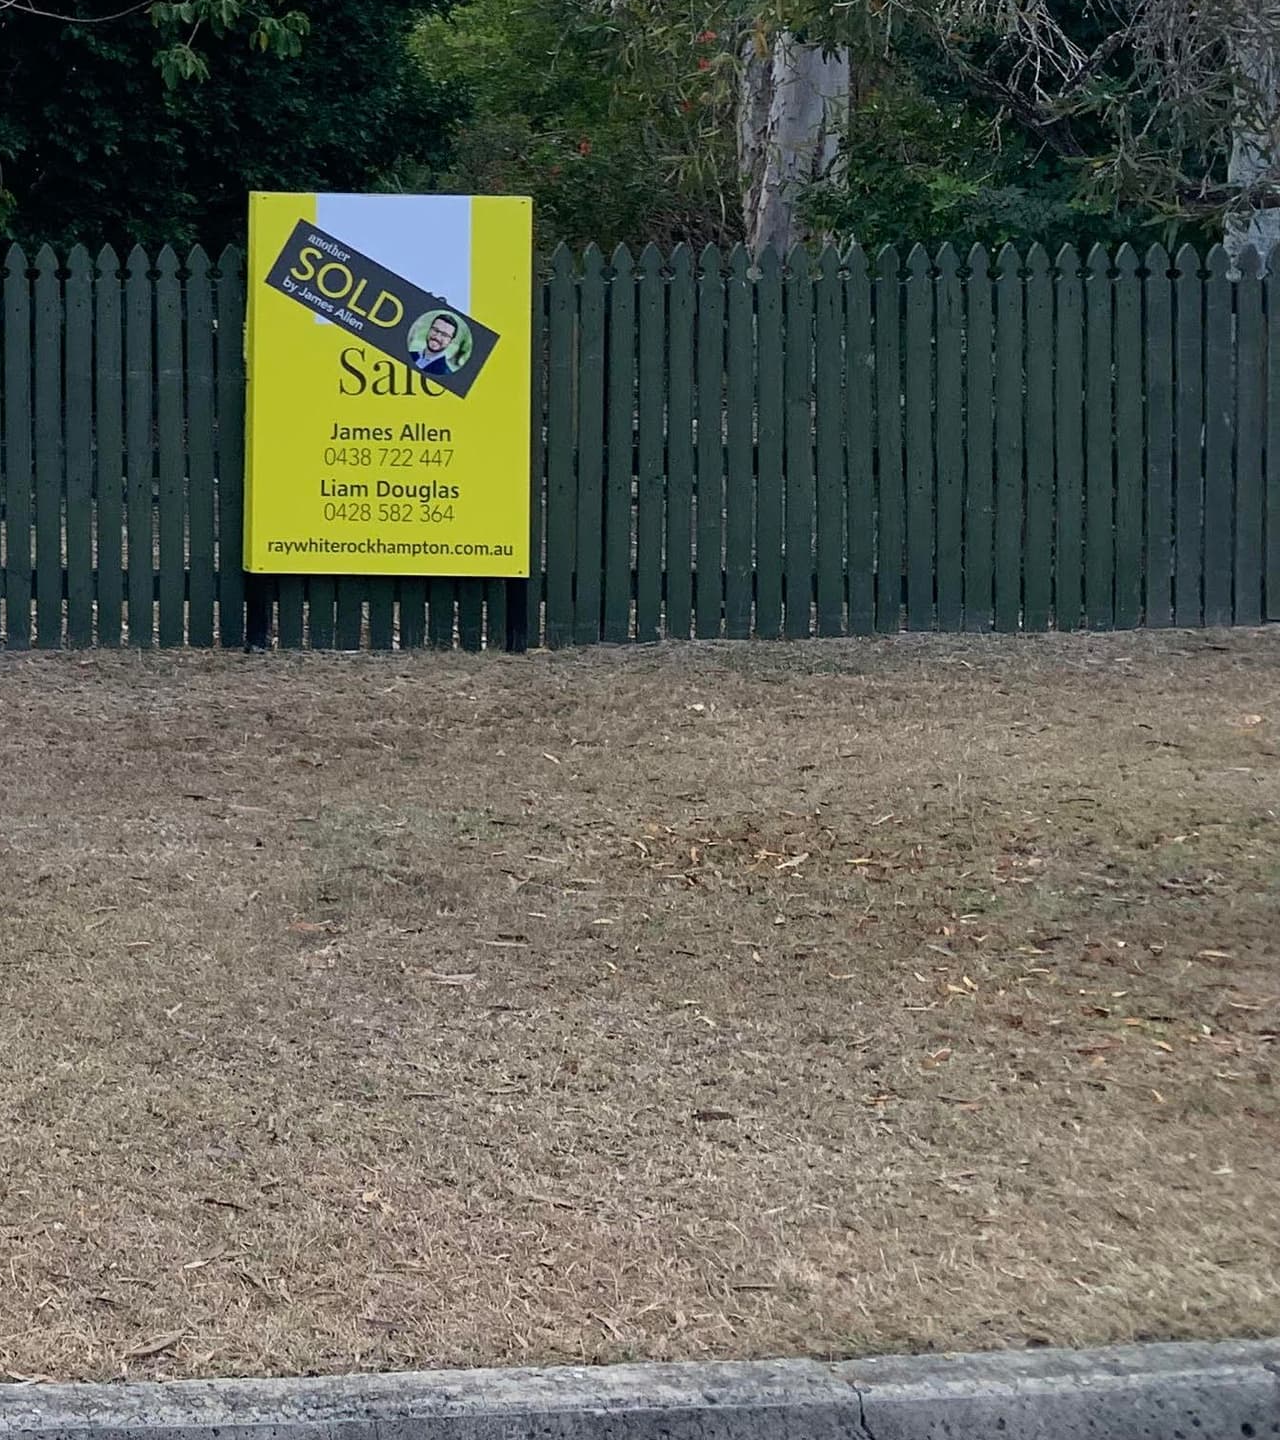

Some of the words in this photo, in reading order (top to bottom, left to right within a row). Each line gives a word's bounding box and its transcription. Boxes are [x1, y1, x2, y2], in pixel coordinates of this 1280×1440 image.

[307, 232, 351, 262] another
[290, 246, 404, 328] SOLD
[282, 274, 299, 293] by
[298, 286, 335, 313] James
[334, 308, 364, 331] Allen
[330, 423, 393, 441] James
[399, 423, 452, 442] Allen
[324, 447, 372, 466] 0438
[379, 448, 414, 467] 722
[419, 449, 454, 467] 447
[320, 479, 369, 498] Liam
[376, 480, 460, 503] Douglas
[324, 503, 372, 522] 0428
[378, 504, 414, 522] 582
[420, 504, 455, 523] 364
[267, 537, 514, 557] raywhiterockhampton.com.au
